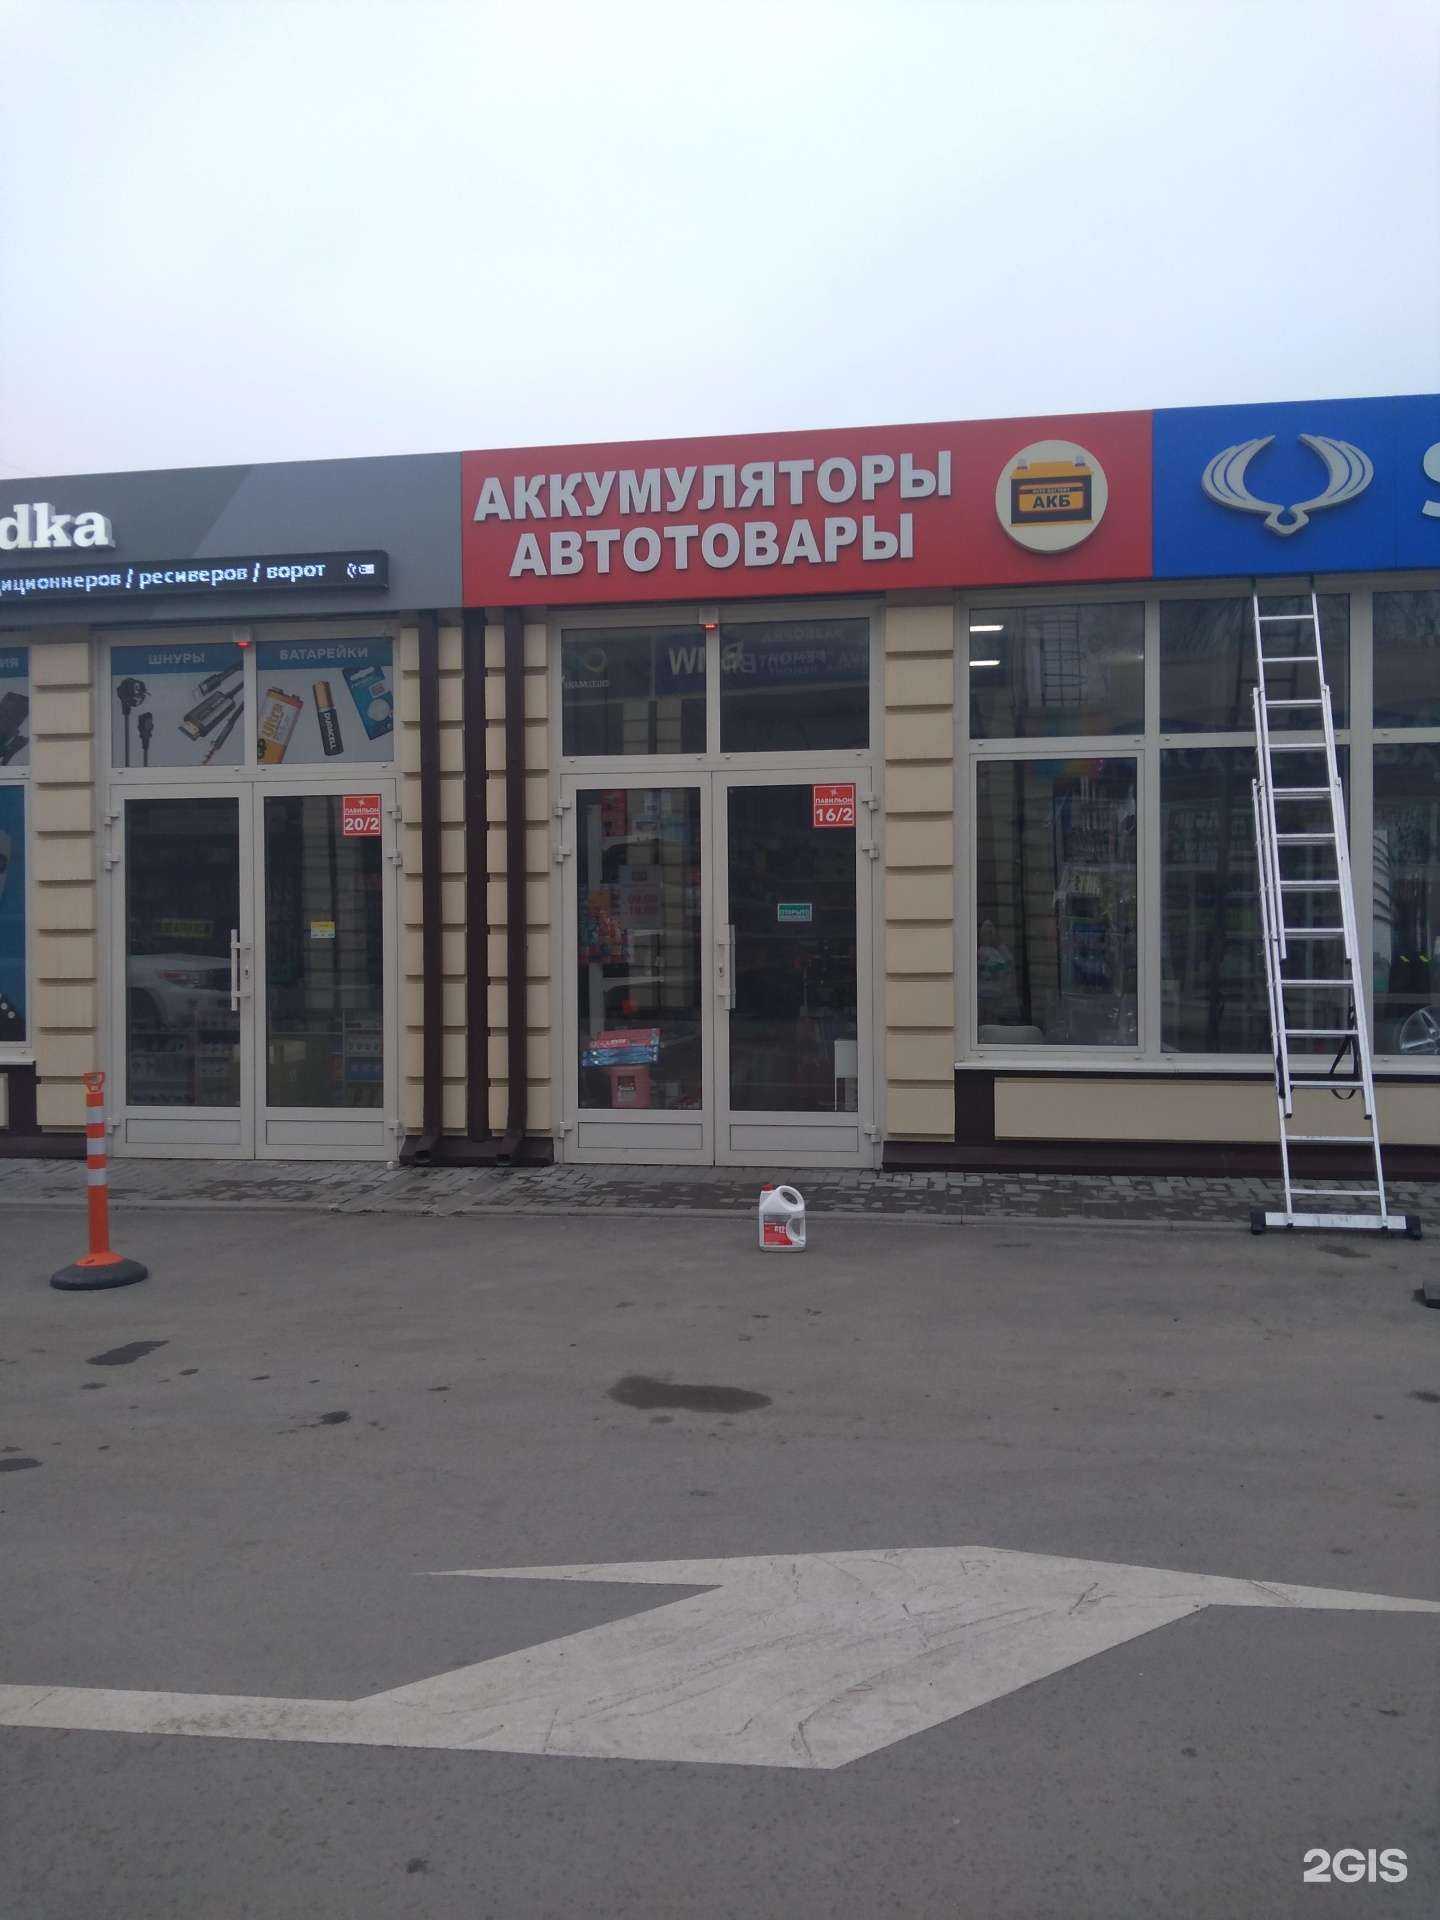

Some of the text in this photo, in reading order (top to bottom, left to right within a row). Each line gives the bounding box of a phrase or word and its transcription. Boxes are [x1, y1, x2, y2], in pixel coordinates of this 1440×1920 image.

[473, 450, 952, 522] АККУМУЛЯТОРЫ
[1032, 494, 1071, 509] АКБ
[508, 513, 914, 578] АВТОТОВАРЫ
[0, 573, 121, 596] иционнеров
[139, 568, 248, 590] ресиверов
[266, 564, 326, 583] ворот
[148, 652, 206, 665] ШНУРЫ
[280, 645, 368, 661] БАТАРЕЙКИ
[816, 807, 853, 822] 16/2
[345, 817, 379, 831] 20/2
